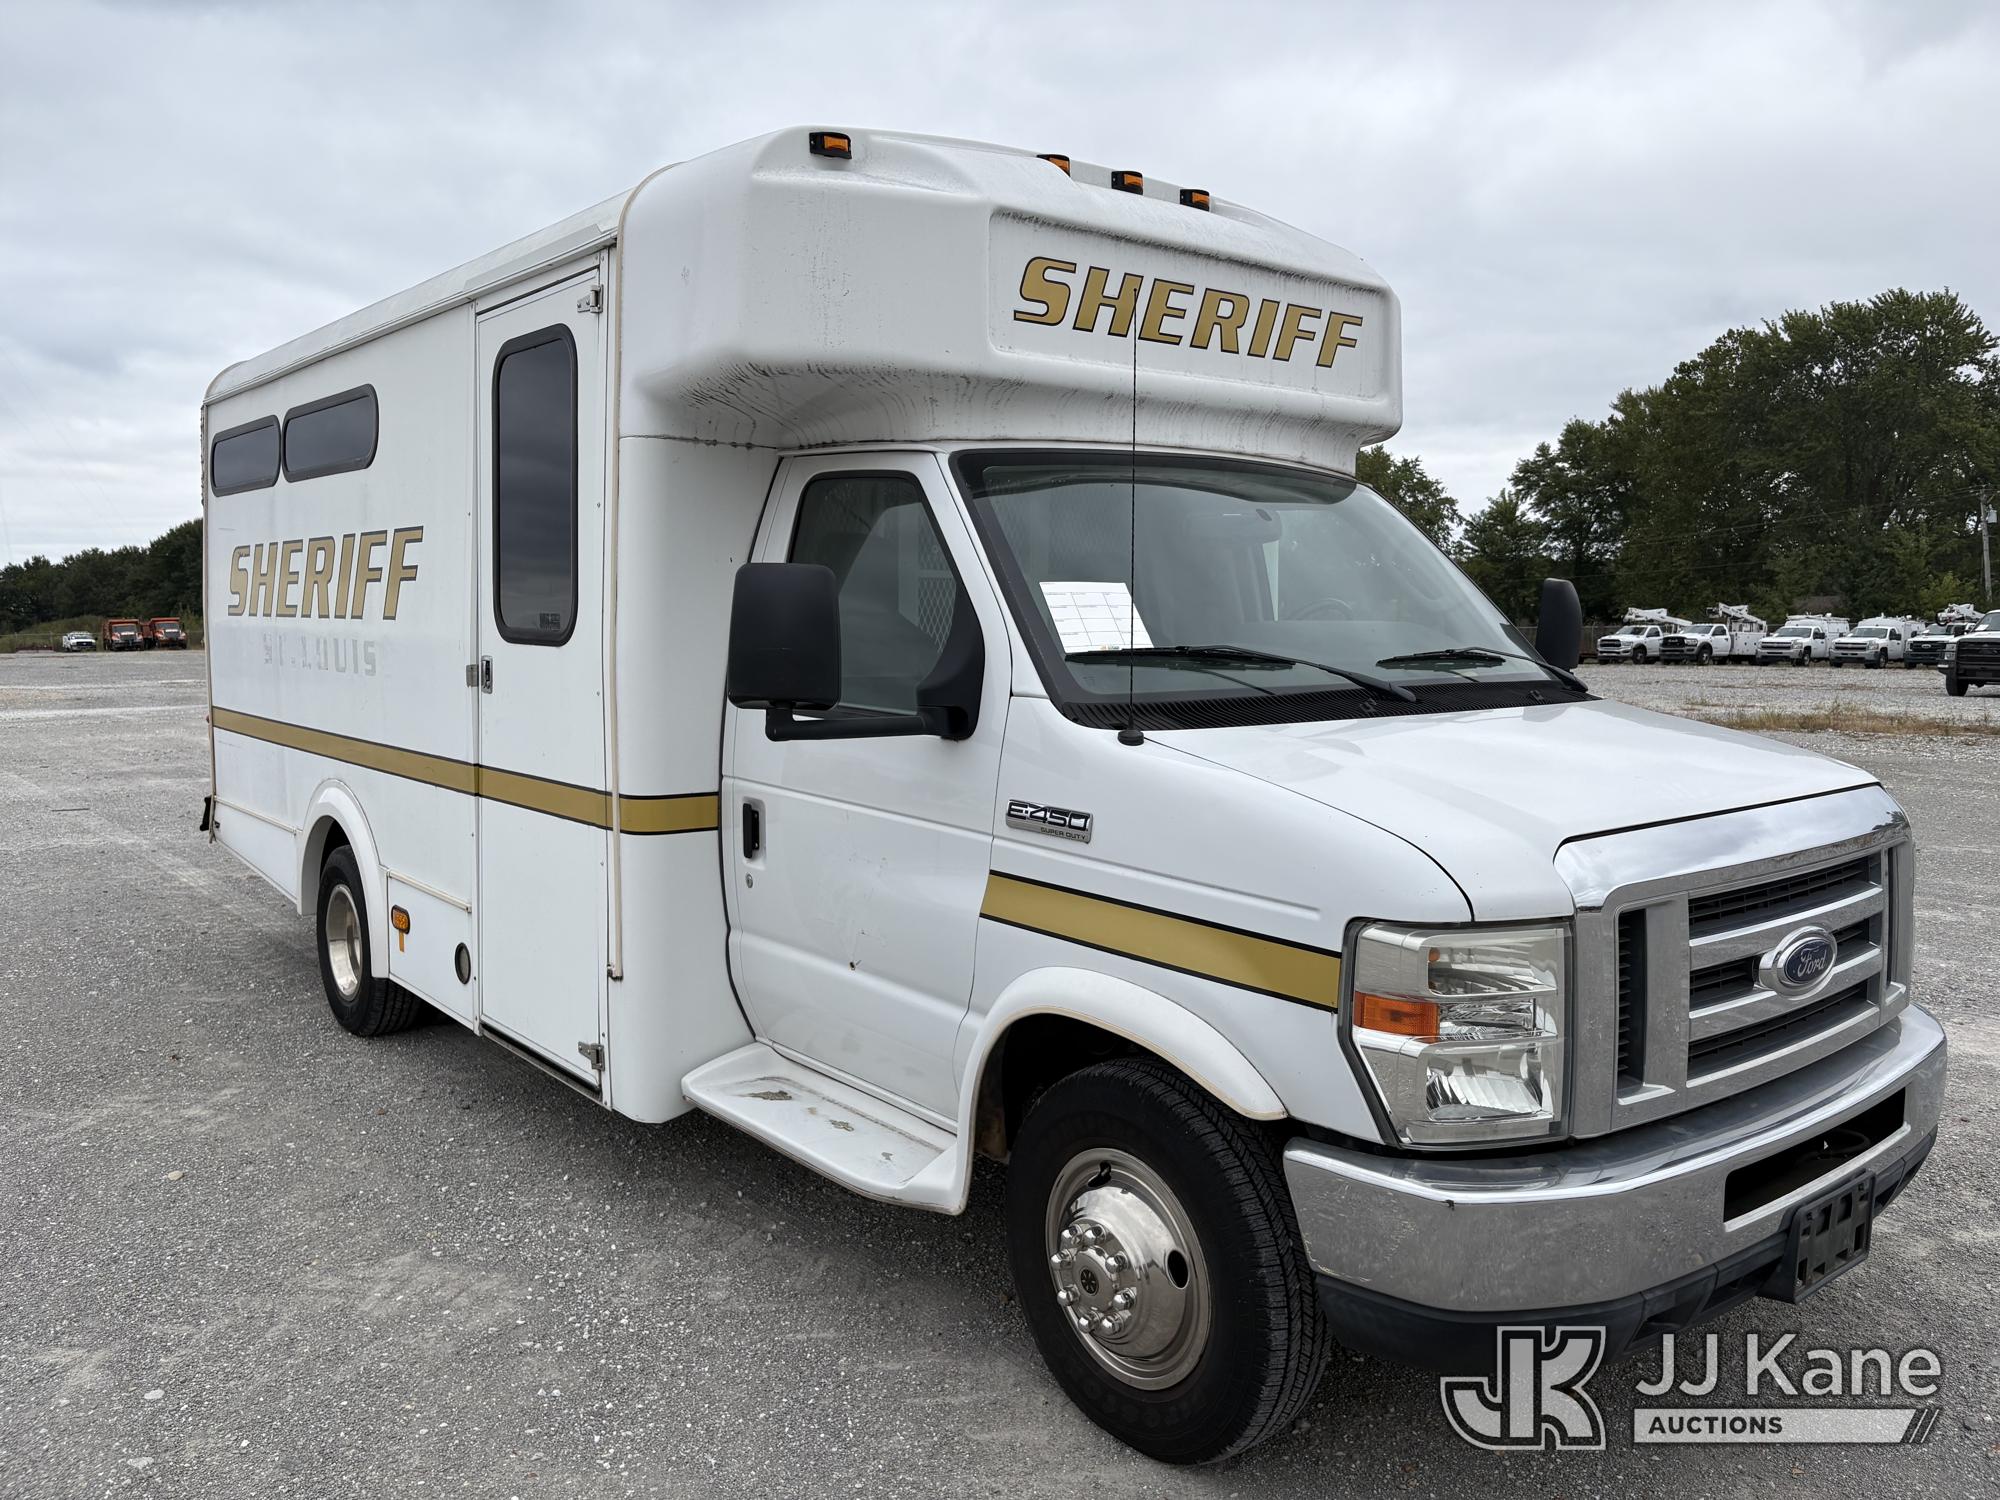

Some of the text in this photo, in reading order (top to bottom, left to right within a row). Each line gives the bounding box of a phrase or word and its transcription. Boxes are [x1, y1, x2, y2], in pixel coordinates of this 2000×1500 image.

[1014, 256, 1364, 368] SHERIFF
[228, 525, 424, 620] SHERIFF
[1040, 827, 1086, 840] SUPER DUTY
[1797, 945, 1827, 977] Ford
